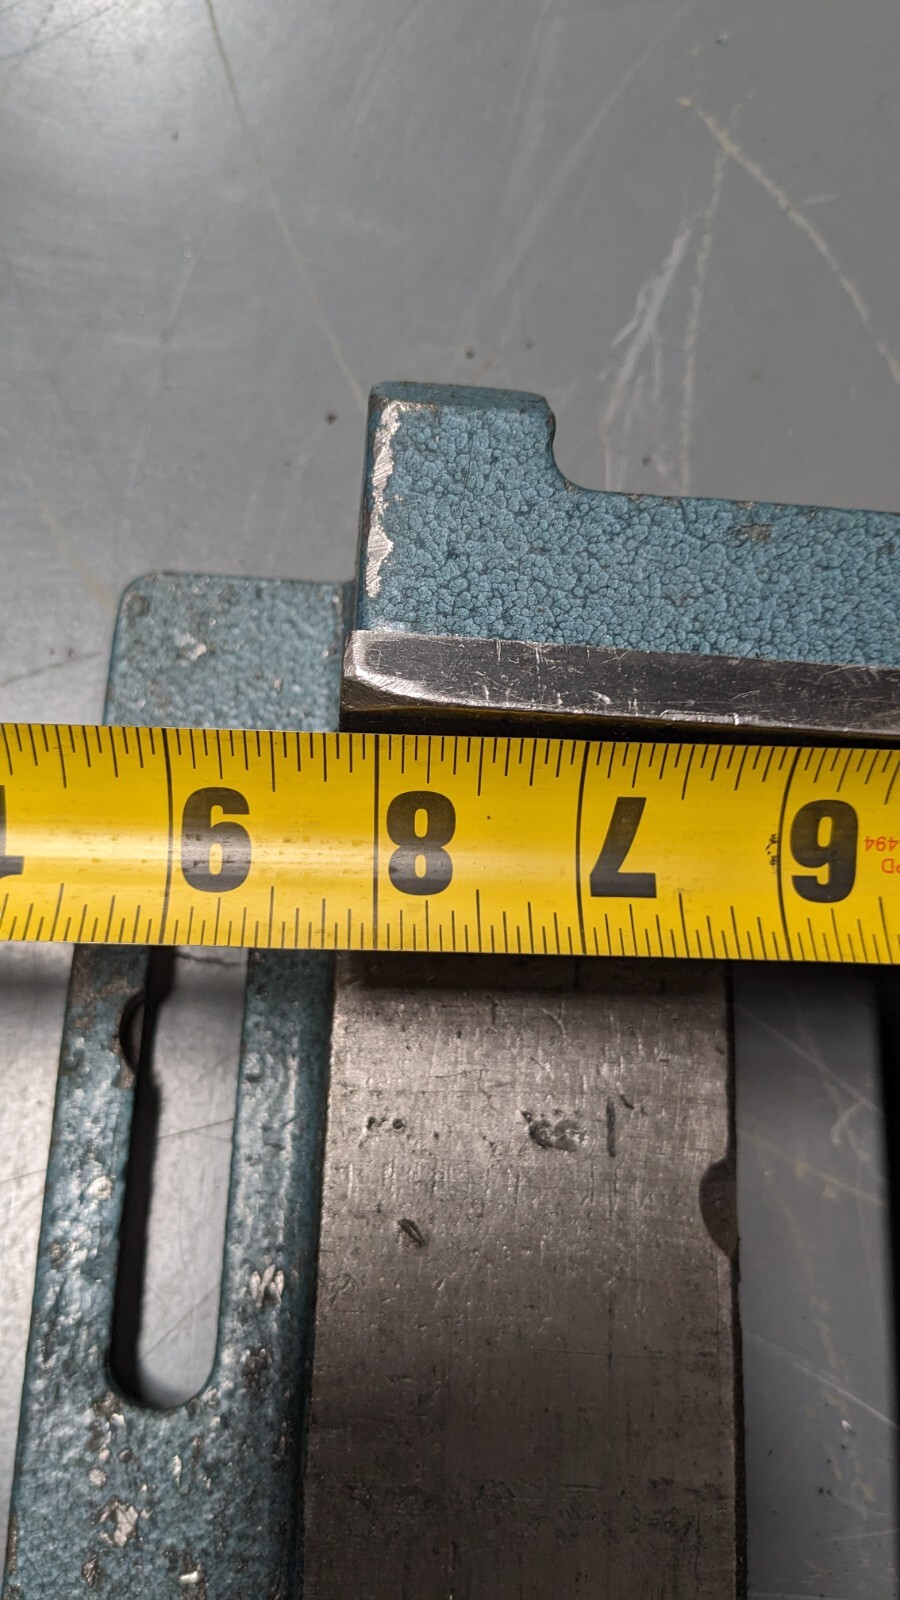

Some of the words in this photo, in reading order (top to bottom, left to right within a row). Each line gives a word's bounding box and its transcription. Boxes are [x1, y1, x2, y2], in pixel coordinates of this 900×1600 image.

[181, 787, 251, 893] 9
[387, 791, 456, 896] 8
[589, 797, 656, 898] 7
[790, 800, 859, 904] 6
